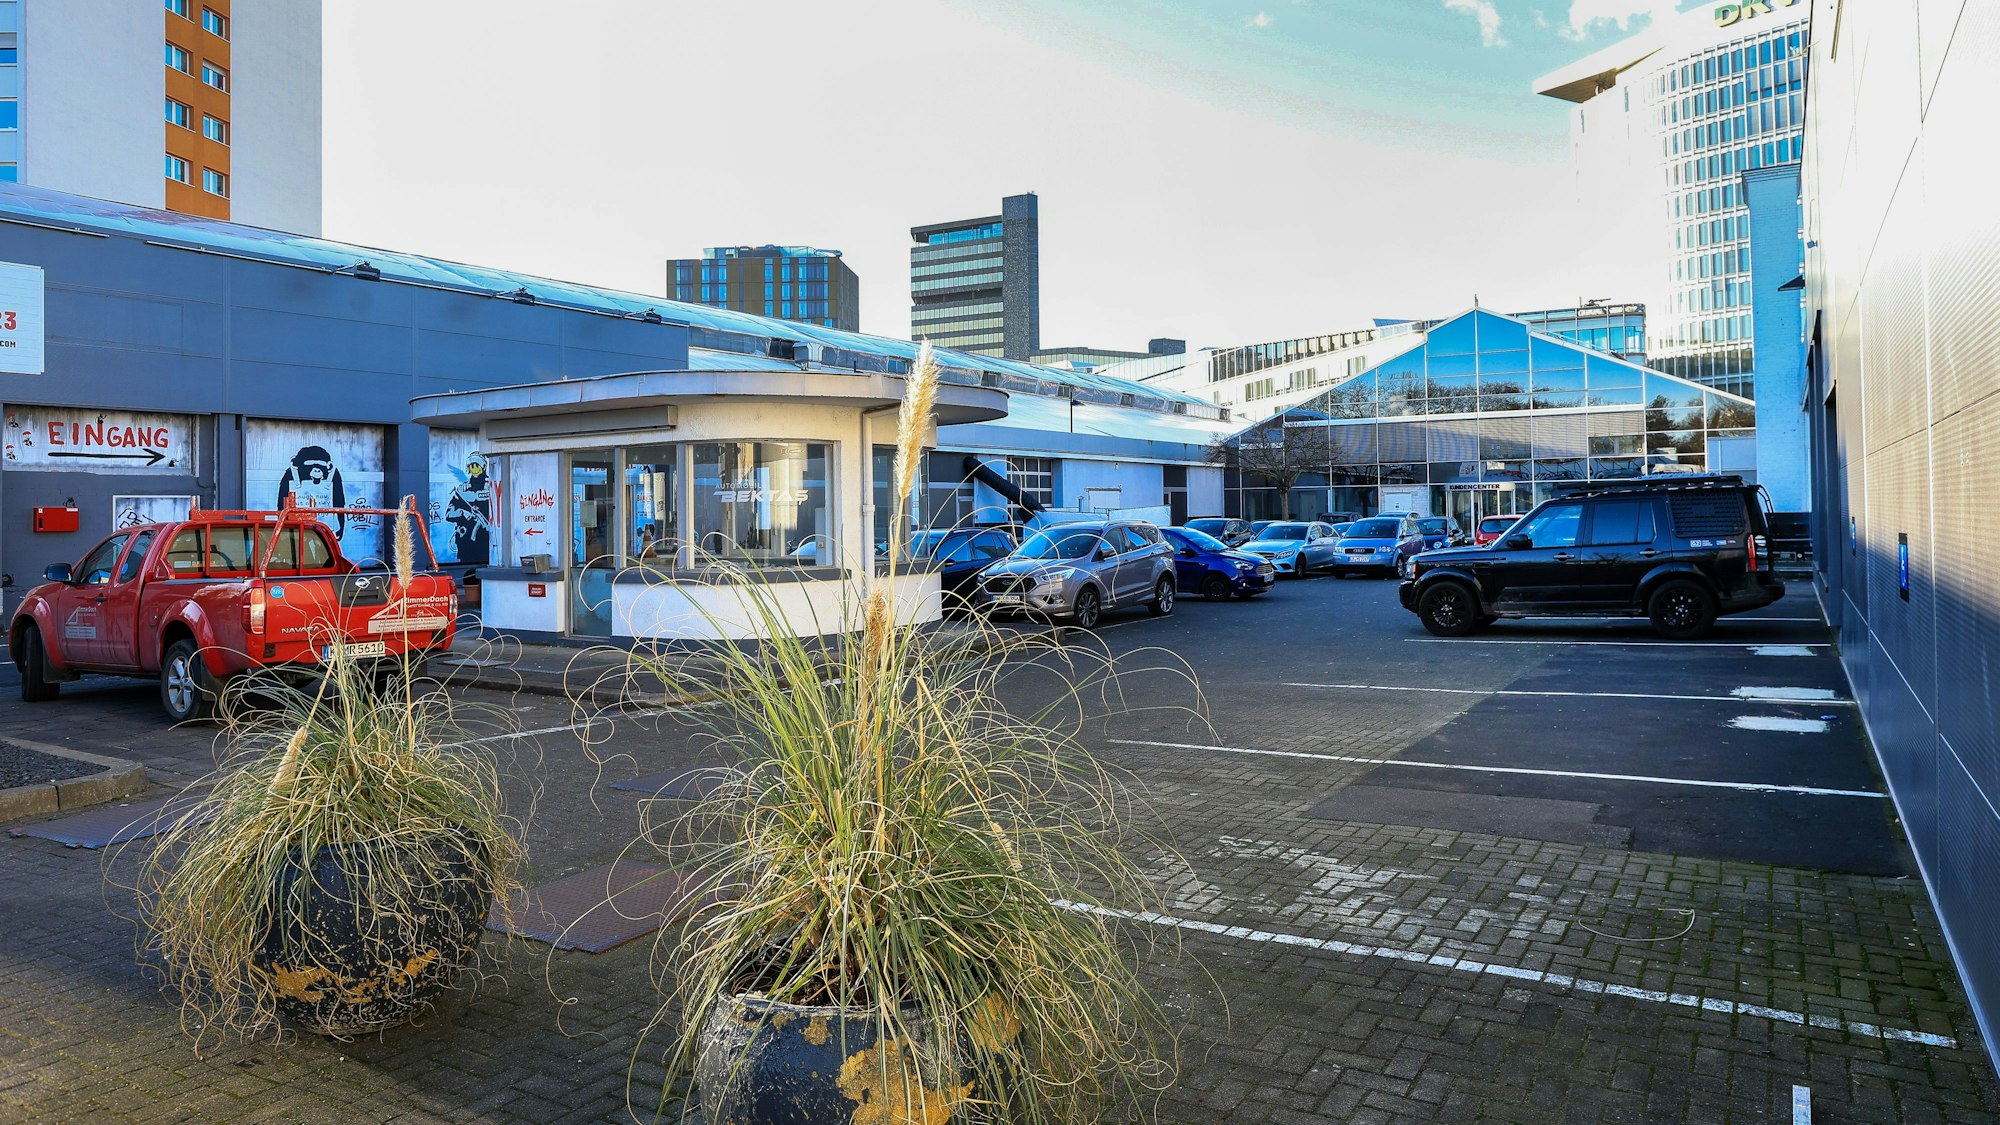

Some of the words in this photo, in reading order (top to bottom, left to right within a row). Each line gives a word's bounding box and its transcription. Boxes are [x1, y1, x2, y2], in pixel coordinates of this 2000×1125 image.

[1714, 0, 1795, 28] DK
[48, 421, 169, 448] EINGANG
[713, 490, 809, 505] BEKTAŞ
[358, 642, 384, 655] 5610
